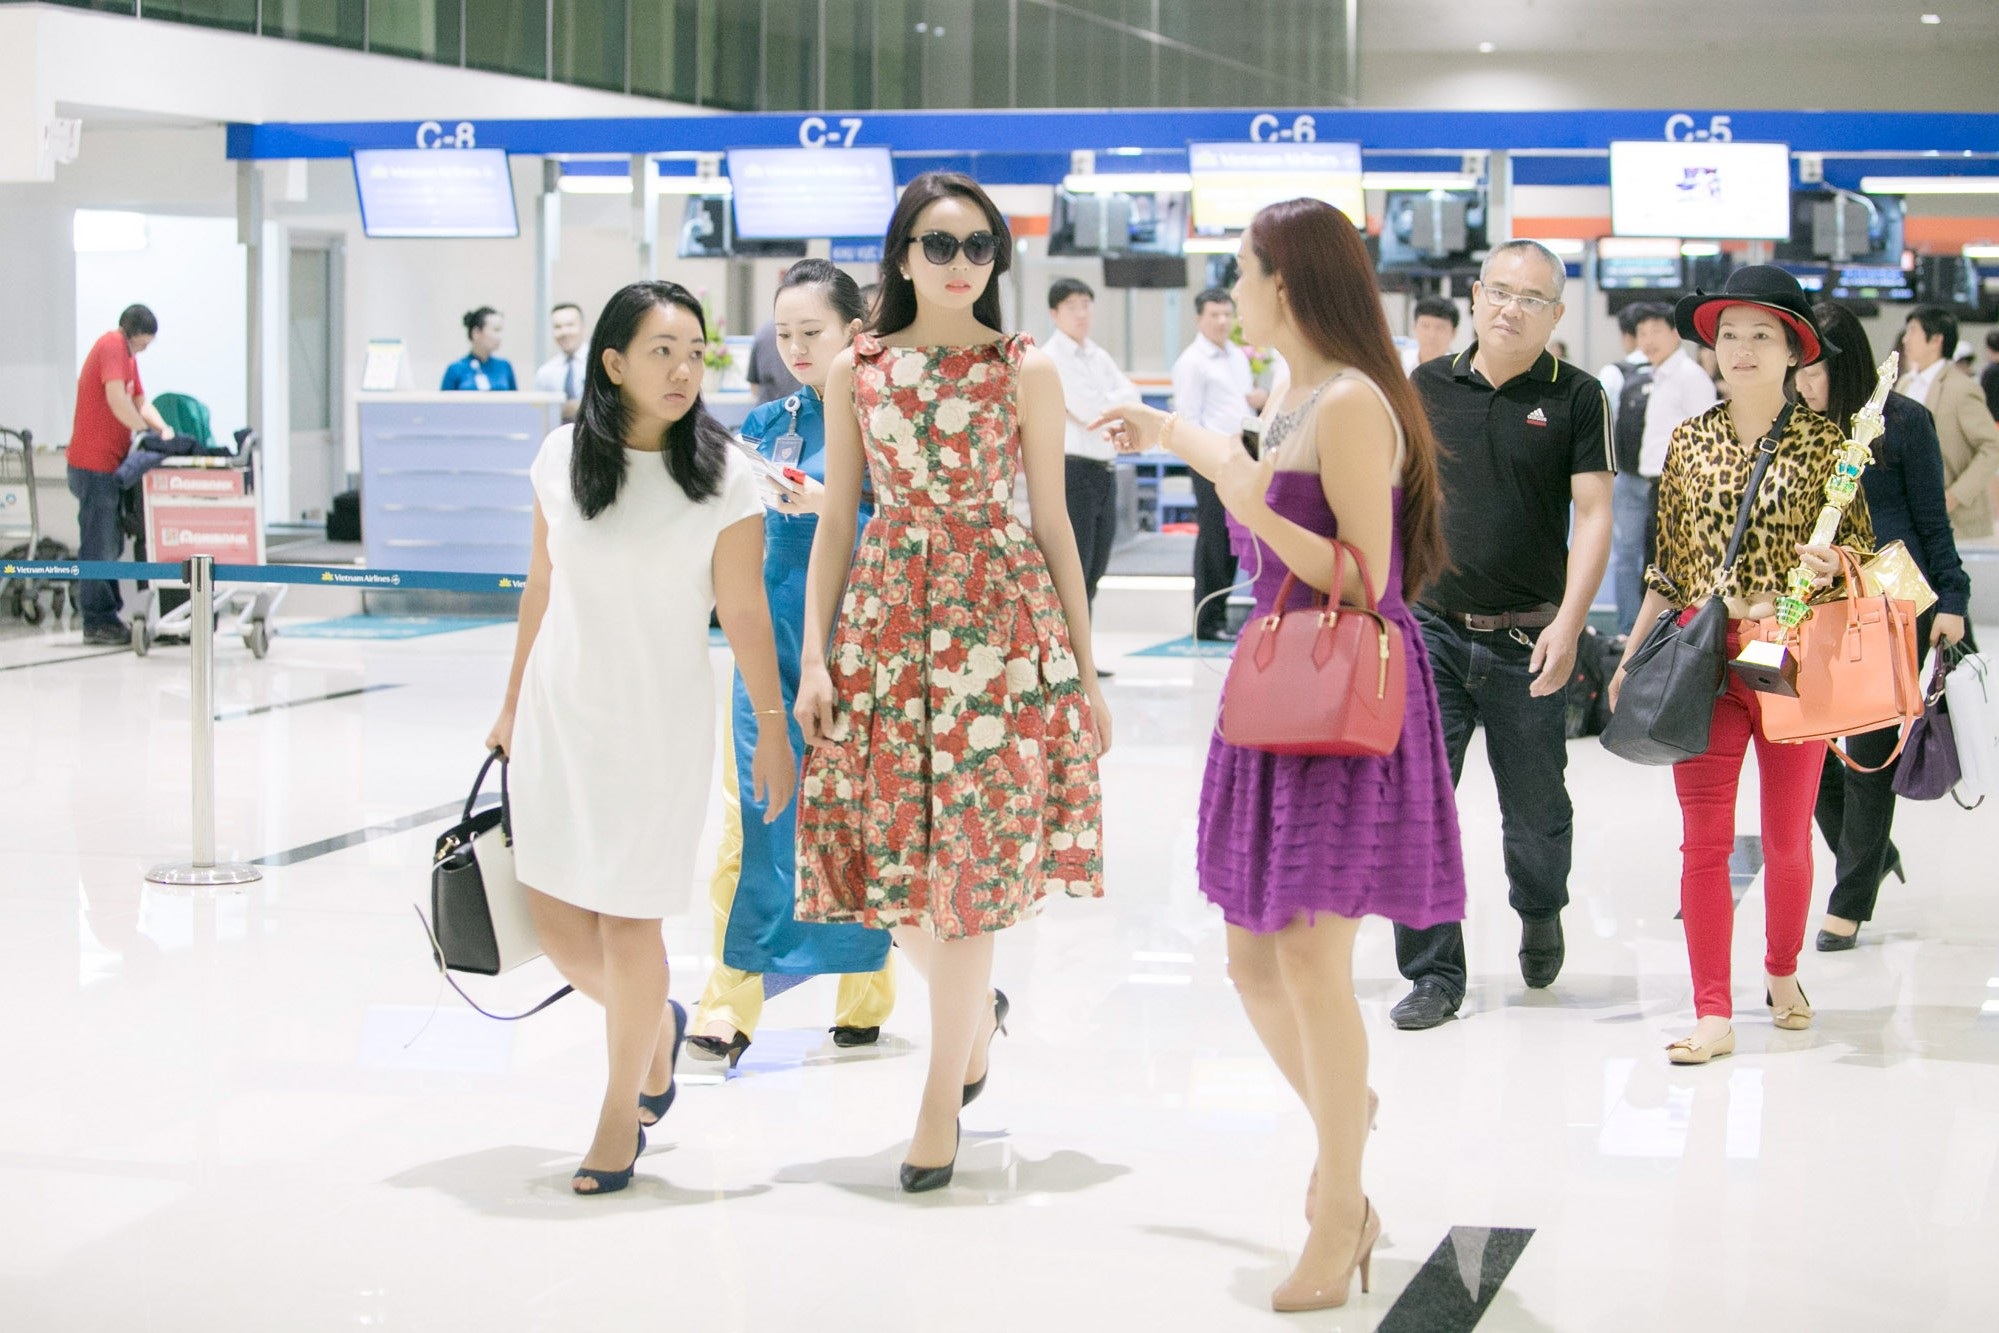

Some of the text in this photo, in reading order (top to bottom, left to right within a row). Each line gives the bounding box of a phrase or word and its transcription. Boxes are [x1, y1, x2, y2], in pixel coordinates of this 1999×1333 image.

[416, 121, 476, 148] C-8
[799, 117, 863, 148] C-7
[1250, 113, 1317, 143] C-6
[1664, 113, 1733, 142] C-5
[16, 566, 70, 574] Vietnam Airlines
[334, 573, 391, 583] Vietnam Airlines
